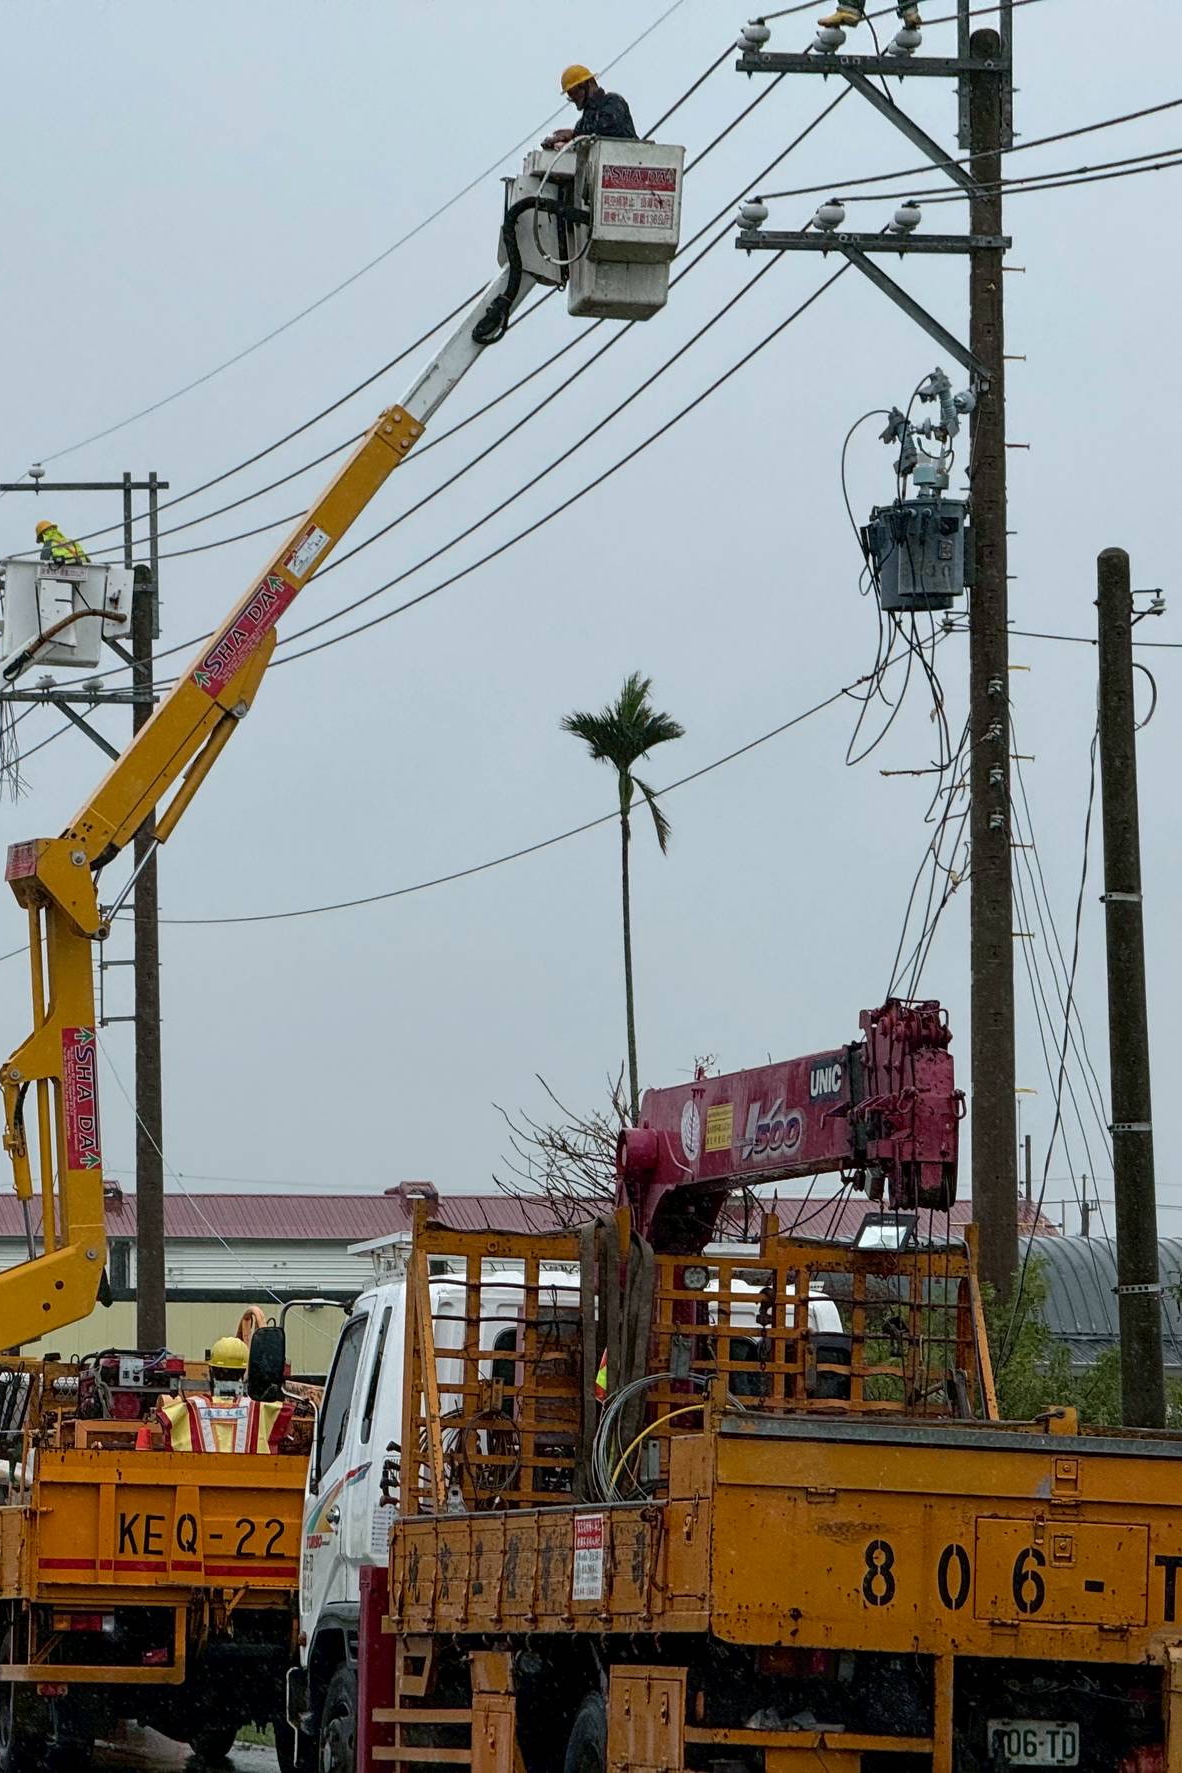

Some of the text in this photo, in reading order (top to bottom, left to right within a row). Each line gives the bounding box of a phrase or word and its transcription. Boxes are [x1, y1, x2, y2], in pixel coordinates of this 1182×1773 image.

[203, 627, 249, 679] SHA
[248, 589, 277, 624] DA
[75, 1045, 95, 1151] SHA DA
[810, 1064, 841, 1096] UNIC
[118, 1513, 285, 1558] KEQ-22
